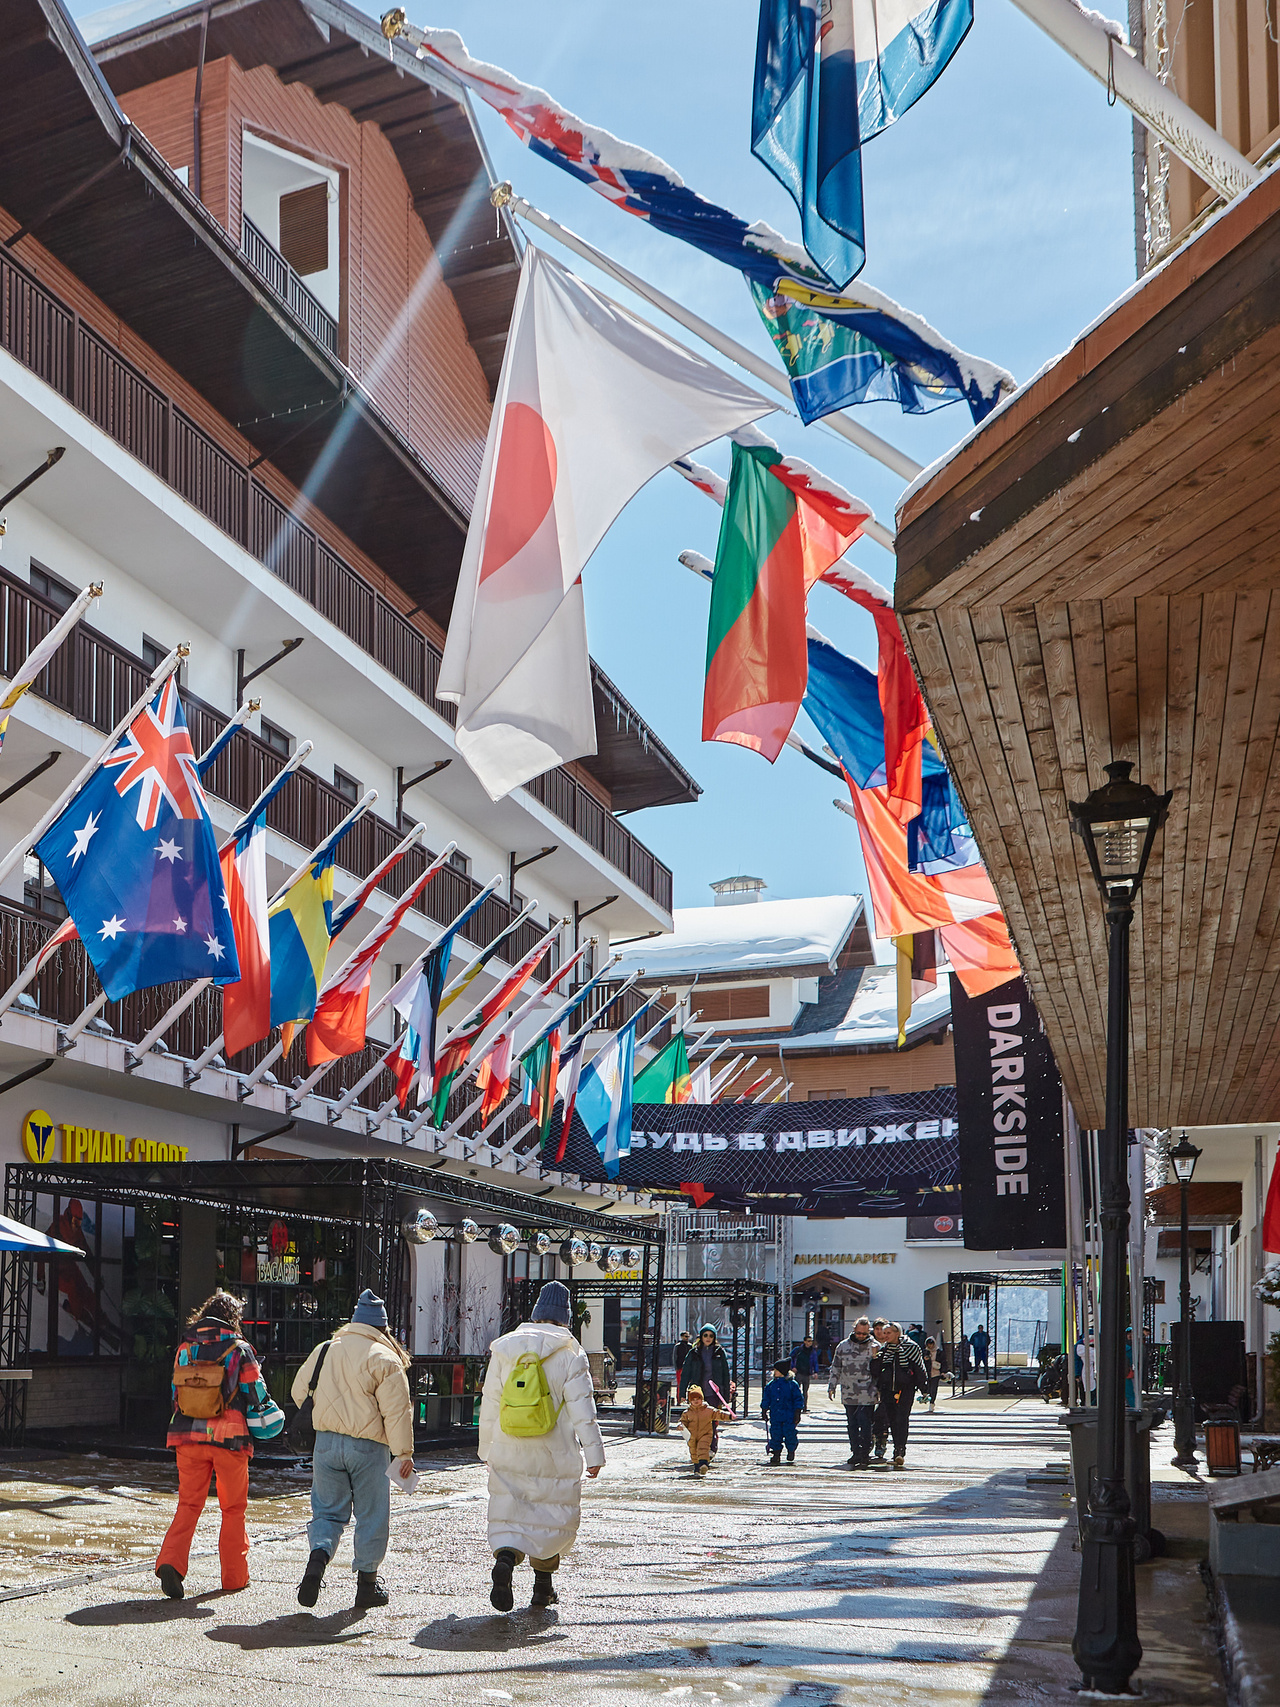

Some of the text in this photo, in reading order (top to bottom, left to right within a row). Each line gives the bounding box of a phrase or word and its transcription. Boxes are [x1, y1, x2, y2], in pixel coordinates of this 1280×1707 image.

[987, 1003, 1029, 1196] DARKSIDE
[631, 1131, 729, 1153] БУДЬ
[738, 1132, 766, 1151] В
[794, 1252, 898, 1265] МИНИМАРКЕТ
